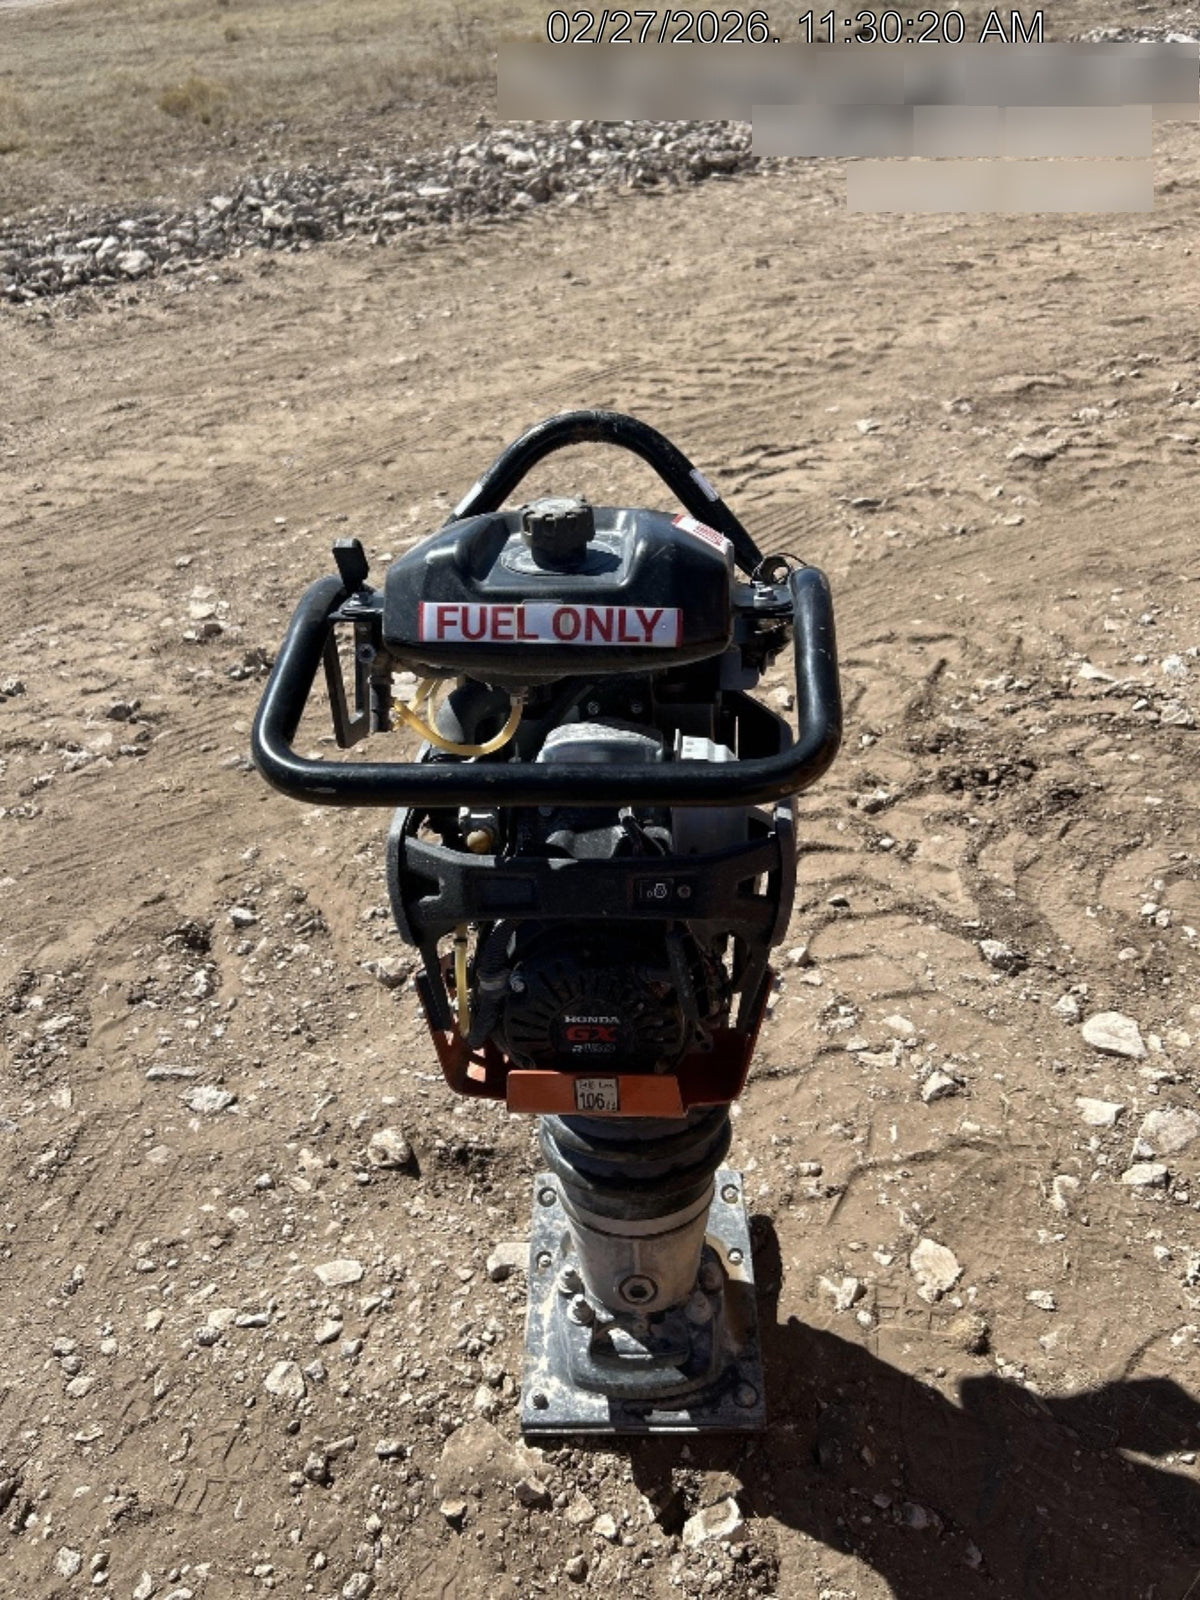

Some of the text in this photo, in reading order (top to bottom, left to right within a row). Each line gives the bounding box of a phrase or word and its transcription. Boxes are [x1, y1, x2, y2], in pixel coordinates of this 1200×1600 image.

[437, 606, 664, 643] FUEL ONLY
[564, 1015, 620, 1024] HONDA
[566, 1025, 618, 1042] GX
